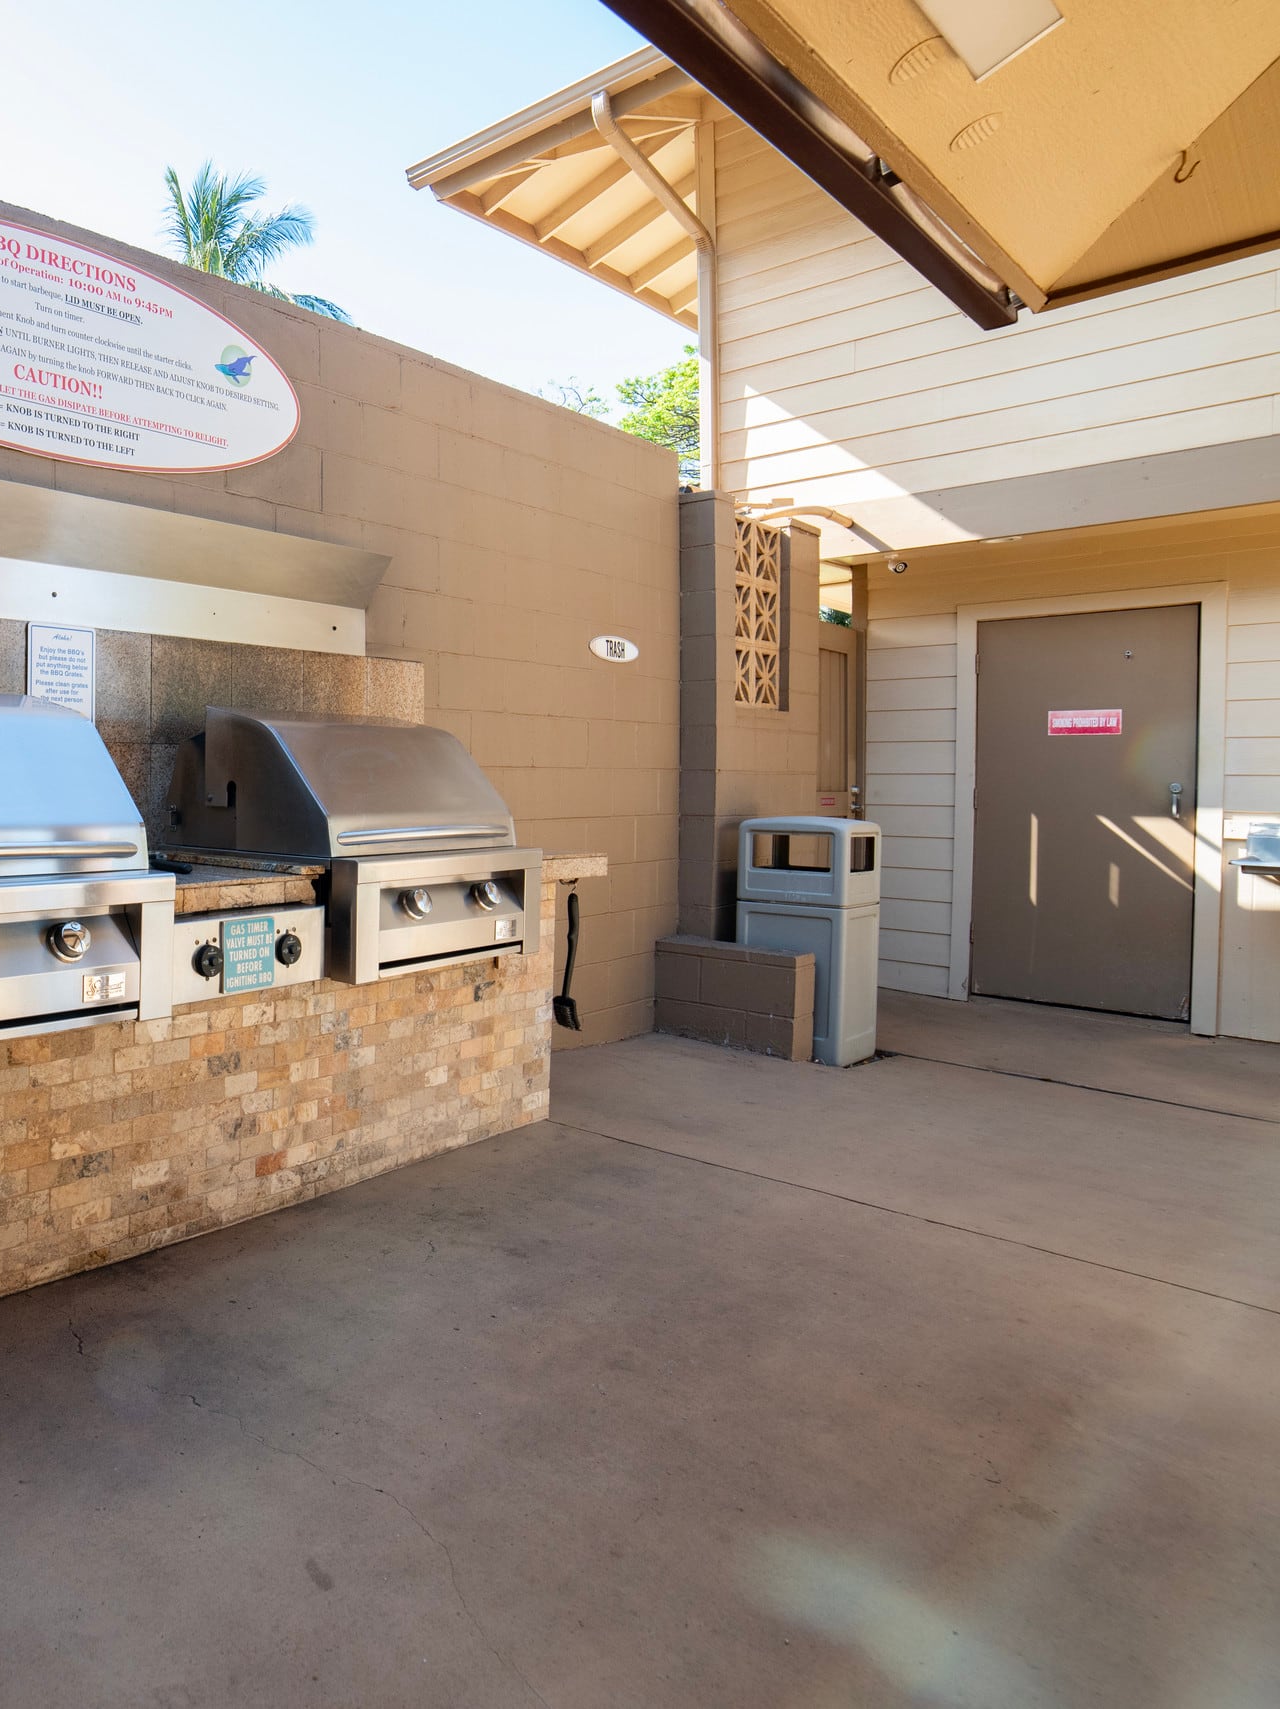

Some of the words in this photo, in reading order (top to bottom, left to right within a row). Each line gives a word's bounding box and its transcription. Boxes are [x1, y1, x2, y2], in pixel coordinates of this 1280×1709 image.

[11, 259, 64, 284] Operation:
[69, 277, 103, 296] 10:00
[106, 288, 122, 302] AM
[123, 293, 132, 306] to
[26, 244, 136, 293] DIRECTIONS
[1, 276, 9, 285] to
[11, 279, 27, 290] start
[28, 283, 64, 302] barbeque,
[65, 294, 80, 306] LID
[81, 299, 105, 313] MUST
[107, 307, 118, 317] BE
[119, 310, 143, 324] OPEN.
[35, 302, 52, 315] Turn
[54, 309, 63, 318] on
[64, 310, 85, 324] timer.
[16, 313, 34, 326] Knob
[36, 319, 50, 330] and
[51, 324, 67, 335] turn
[68, 329, 94, 343] counter
[95, 336, 126, 352] clockwise
[127, 345, 141, 356] until
[142, 349, 153, 360] the
[154, 353, 174, 366] starter
[0, 343, 27, 358] AGAIN
[28, 351, 37, 362] by
[39, 354, 64, 370] turning
[65, 361, 77, 371] the
[79, 364, 96, 376] knob
[96, 369, 133, 386] FORWARD
[135, 379, 155, 392] THEN
[156, 385, 175, 397] BACK
[175, 390, 185, 400] TO
[185, 393, 205, 405] CLICK
[5, 328, 31, 342] UNTIL
[33, 335, 66, 351] BURNER
[98, 353, 119, 366] THEN
[121, 359, 152, 375] RELEASE
[153, 368, 168, 380] AND
[170, 373, 195, 387] ADJUST
[197, 381, 215, 393] KNOB
[215, 386, 225, 395] TO
[225, 389, 253, 403] DESIRED
[14, 363, 102, 400] CAUTION!!
[0, 384, 17, 396] LET
[18, 389, 36, 401] THE
[38, 393, 55, 405] GAS
[58, 398, 97, 415] DISIPATE
[99, 408, 131, 423] BEFORE
[132, 416, 182, 436] ATTEMPTING
[184, 429, 193, 438] TO
[6, 403, 32, 417] KNOB
[34, 410, 42, 419] IS
[44, 412, 80, 428] TURNED
[82, 421, 93, 431] TO
[95, 423, 112, 435] THE
[114, 428, 140, 441] RIGHT
[8, 421, 34, 435] KNOB
[36, 427, 44, 437] IS
[46, 429, 82, 445] TURNED
[84, 438, 95, 448] TO
[96, 440, 114, 452] THE
[116, 445, 135, 456] LEFT
[40, 646, 56, 654] Enjoy
[606, 640, 625, 658] TRASH
[226, 937, 246, 949] VALVE
[247, 935, 264, 947] MUST
[266, 933, 273, 944] BE
[231, 924, 245, 935] GAS
[247, 921, 268, 934] TIMER
[229, 950, 257, 962] TURNED
[259, 947, 270, 958] ON
[237, 961, 262, 973] BEFORE
[226, 975, 257, 988] IGNITING
[259, 972, 272, 983] BBQ
